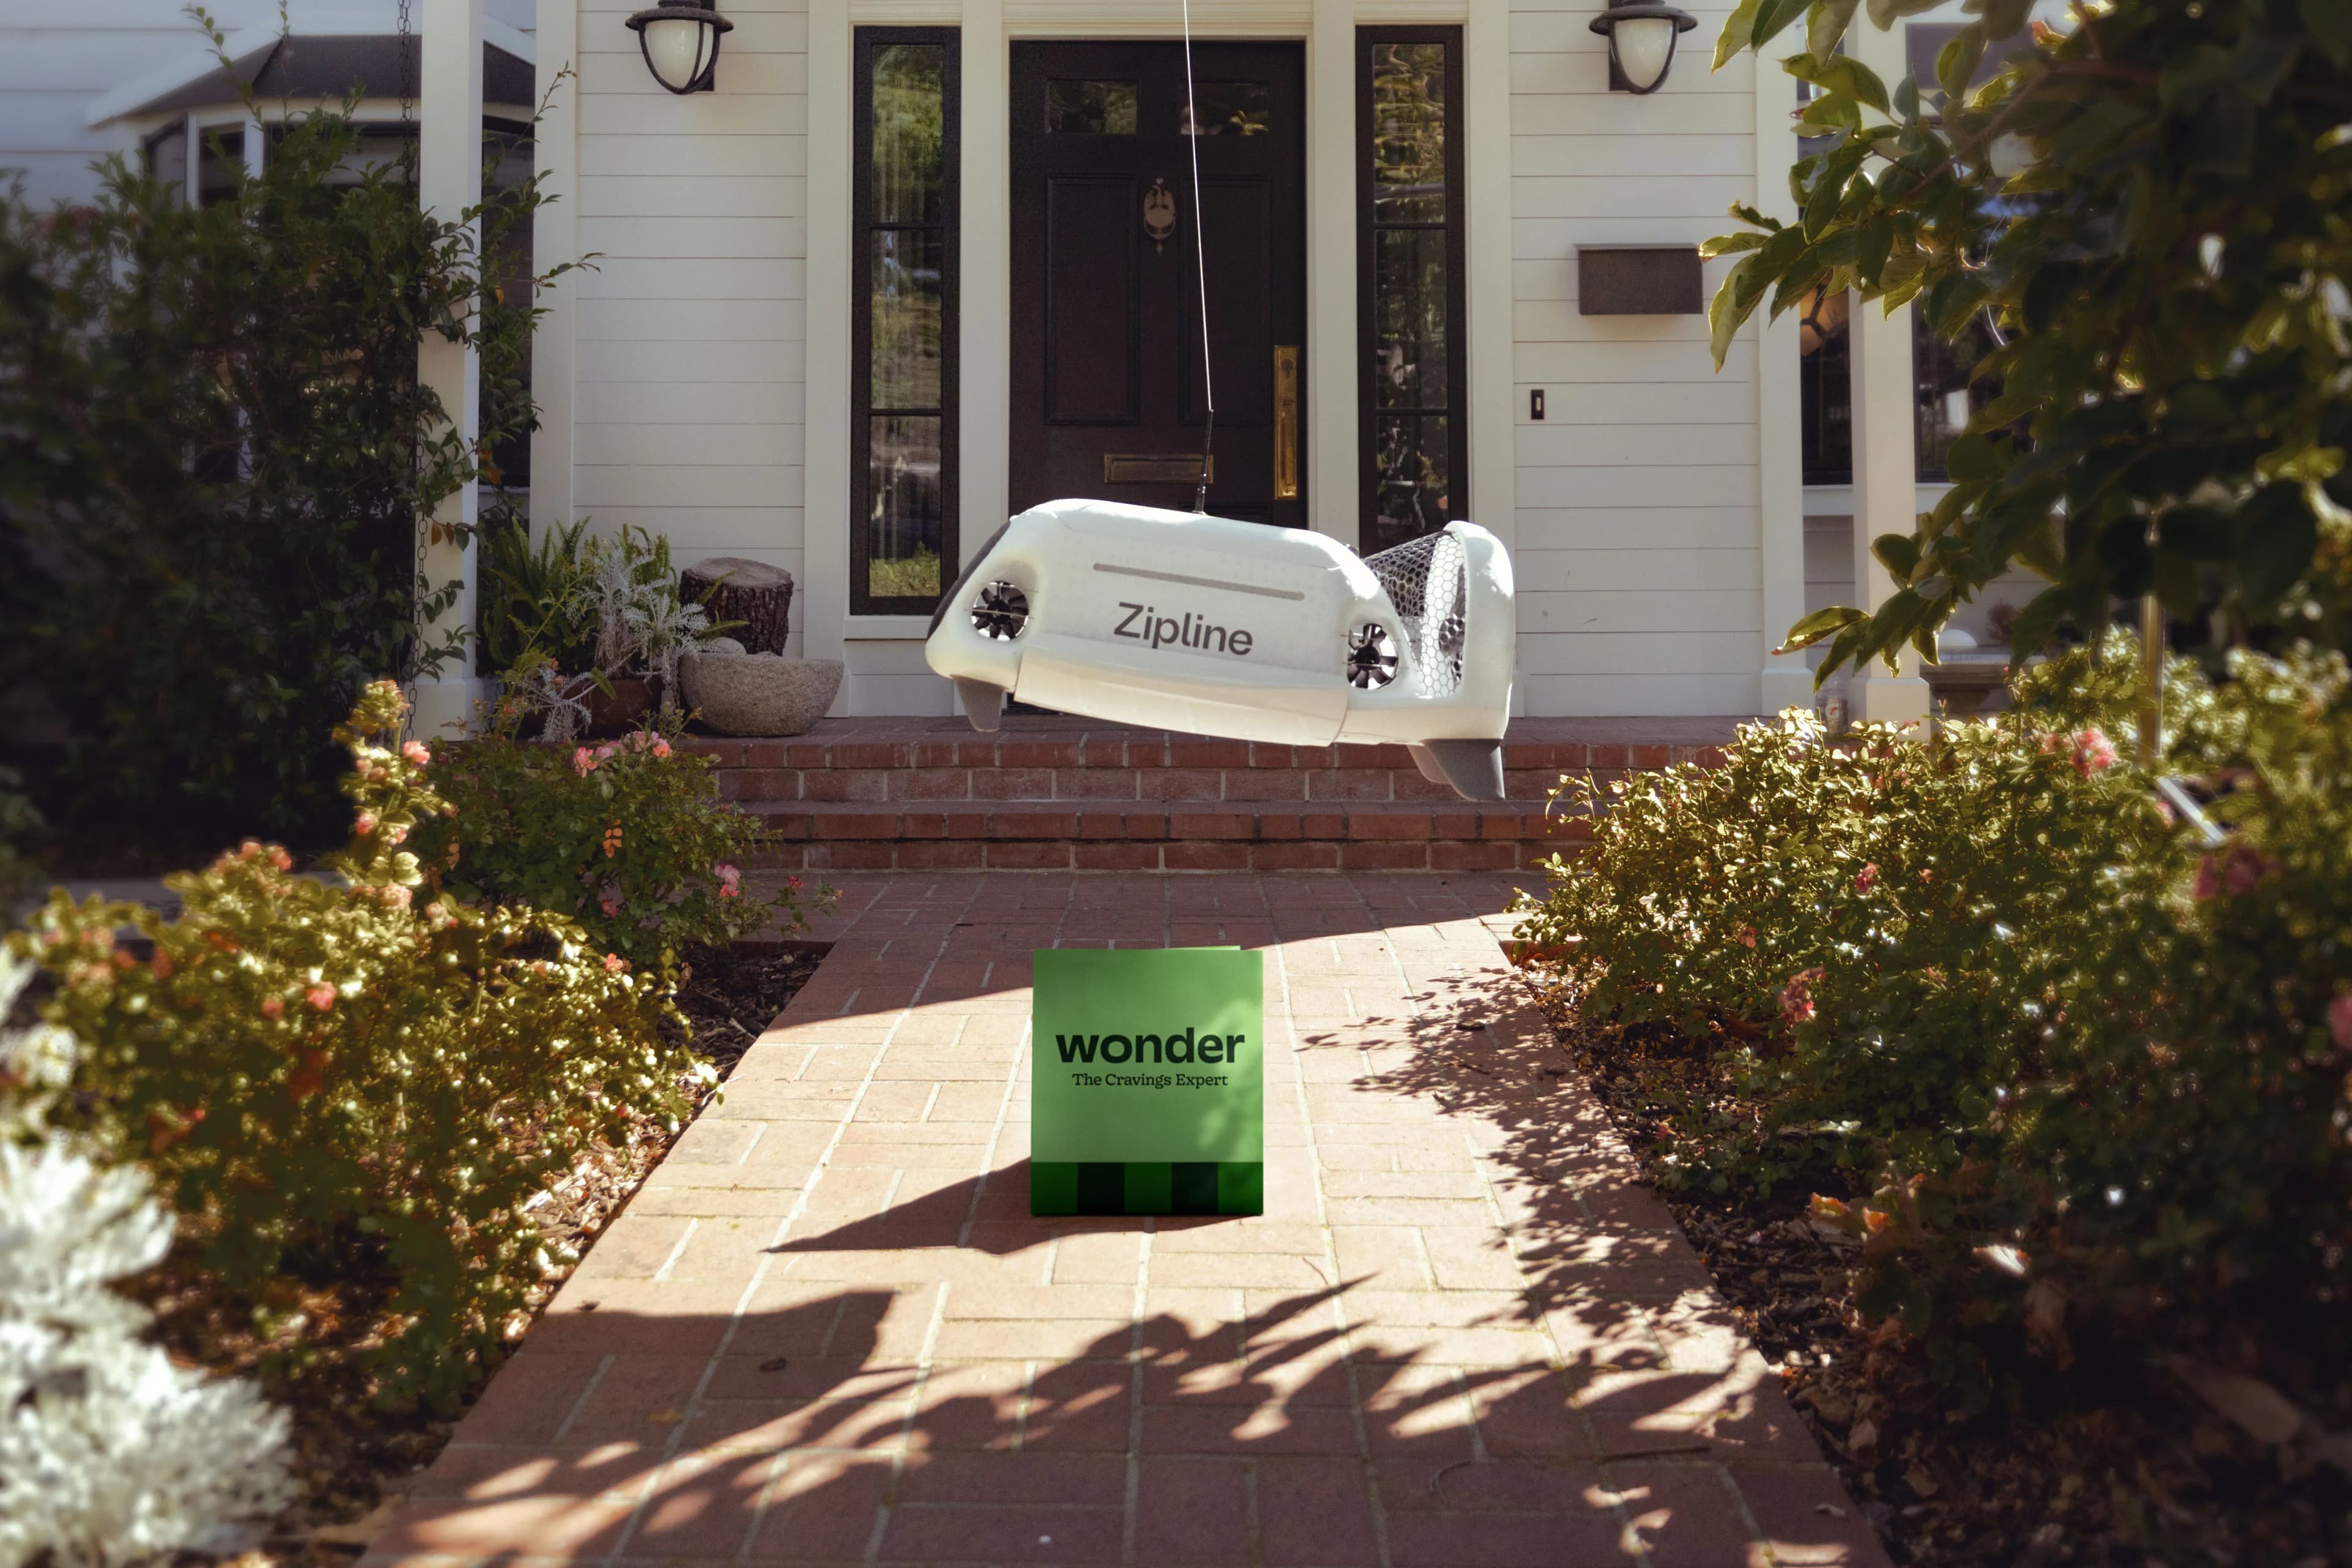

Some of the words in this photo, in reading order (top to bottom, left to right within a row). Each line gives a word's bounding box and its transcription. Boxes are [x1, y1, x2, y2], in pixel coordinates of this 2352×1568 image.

[1114, 601, 1253, 655] Zipline
[1055, 1027, 1245, 1064] wonder
[1072, 1073, 1102, 1086] The
[1105, 1072, 1172, 1089] Cravings
[1175, 1073, 1228, 1089] Expert
